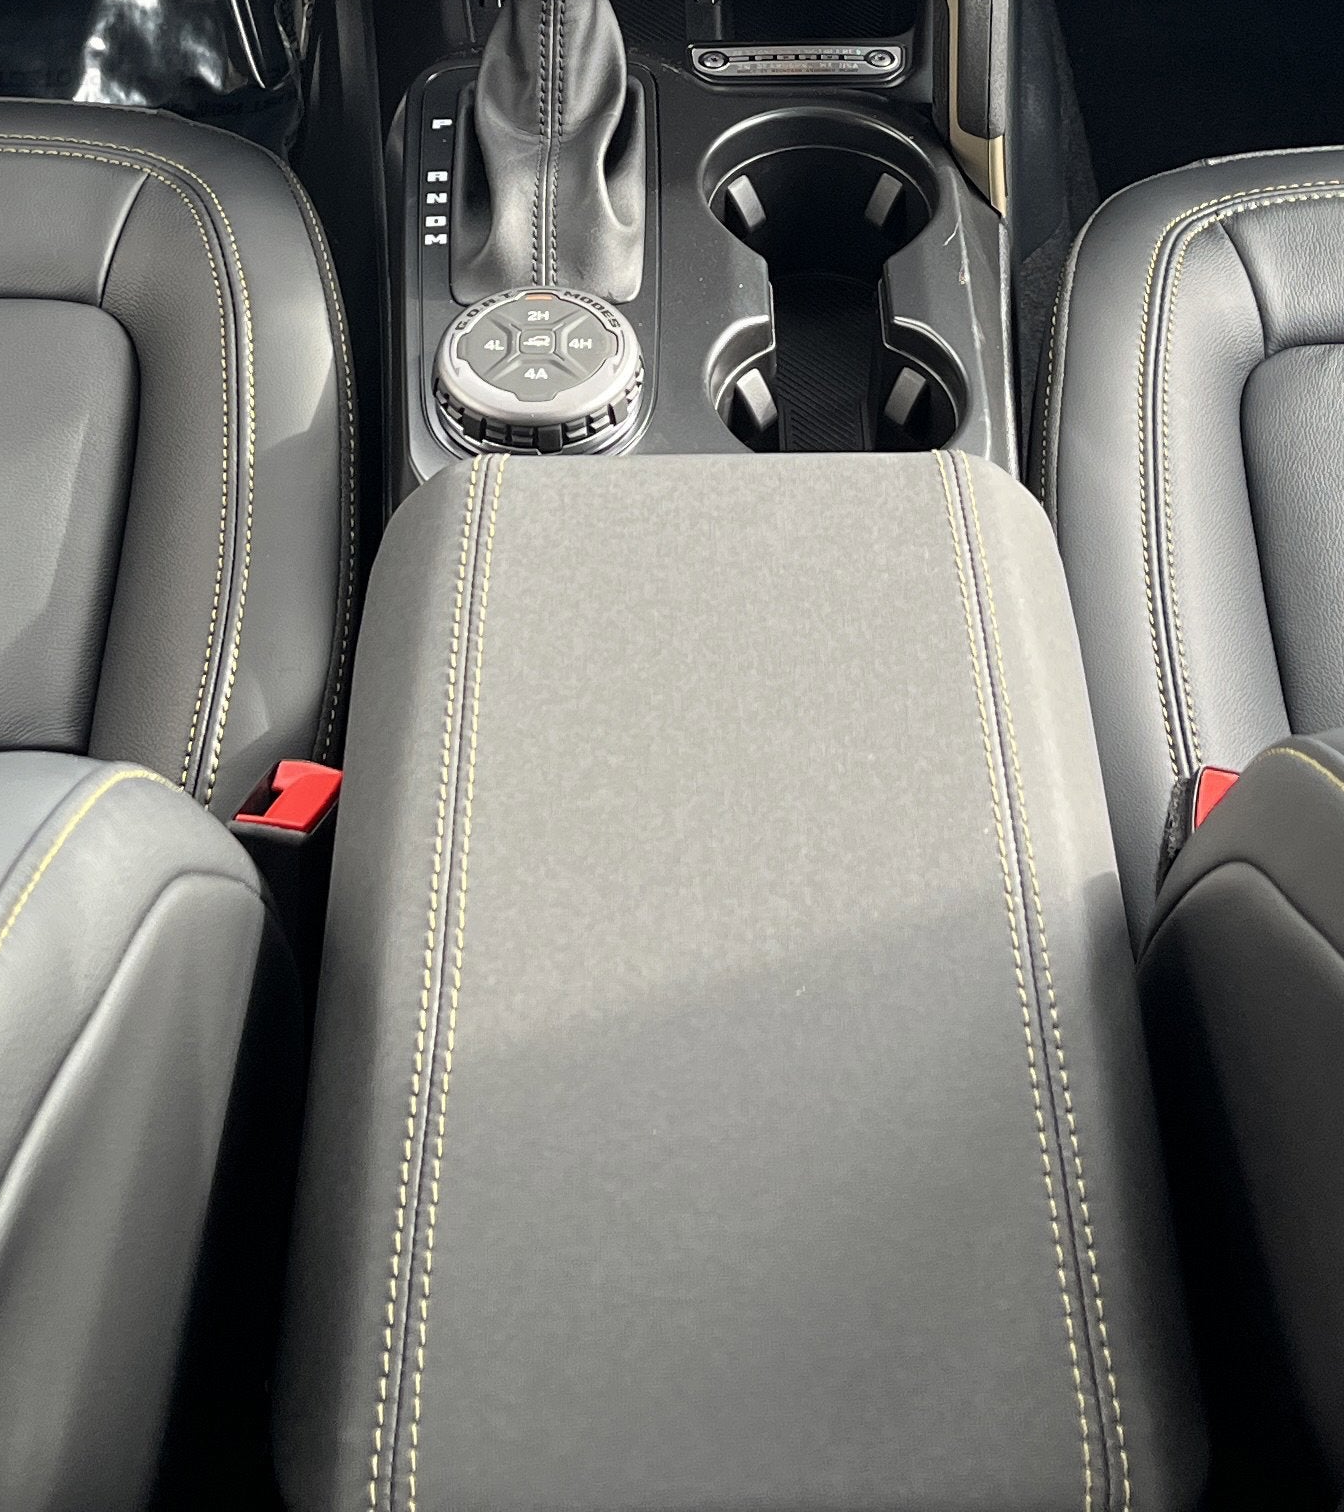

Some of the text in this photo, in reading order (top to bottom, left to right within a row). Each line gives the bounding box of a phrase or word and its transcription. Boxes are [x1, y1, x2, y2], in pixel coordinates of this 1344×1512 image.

[431, 118, 453, 130] P
[427, 170, 448, 182] R
[426, 192, 448, 204] N
[424, 233, 448, 245] M
[564, 290, 622, 329] MODES
[527, 310, 550, 322] 2H
[483, 340, 505, 351] 4L
[568, 338, 593, 350] 4H
[524, 368, 549, 380] 4A
